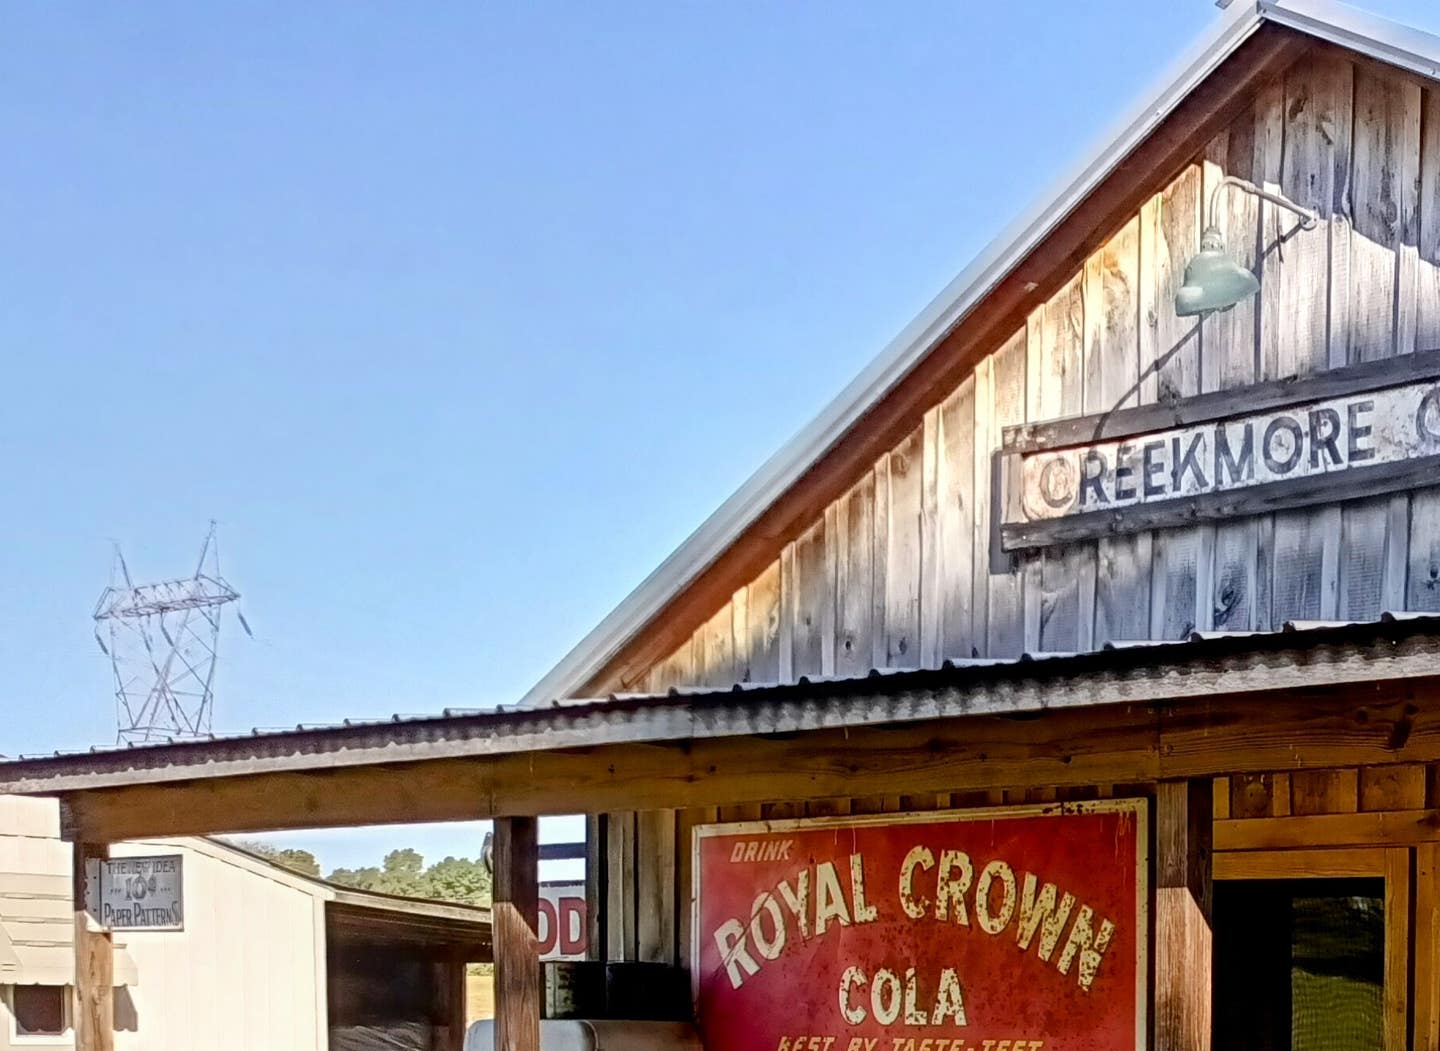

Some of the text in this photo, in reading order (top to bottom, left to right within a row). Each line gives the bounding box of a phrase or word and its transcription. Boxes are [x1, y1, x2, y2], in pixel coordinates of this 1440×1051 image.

[1038, 400, 1376, 509] CREEKMORE
[730, 839, 793, 862] DRINK
[104, 901, 180, 928] PAPER PATTERNS
[713, 845, 1116, 991] ROYAL CROWN
[838, 965, 967, 1026] COLA
